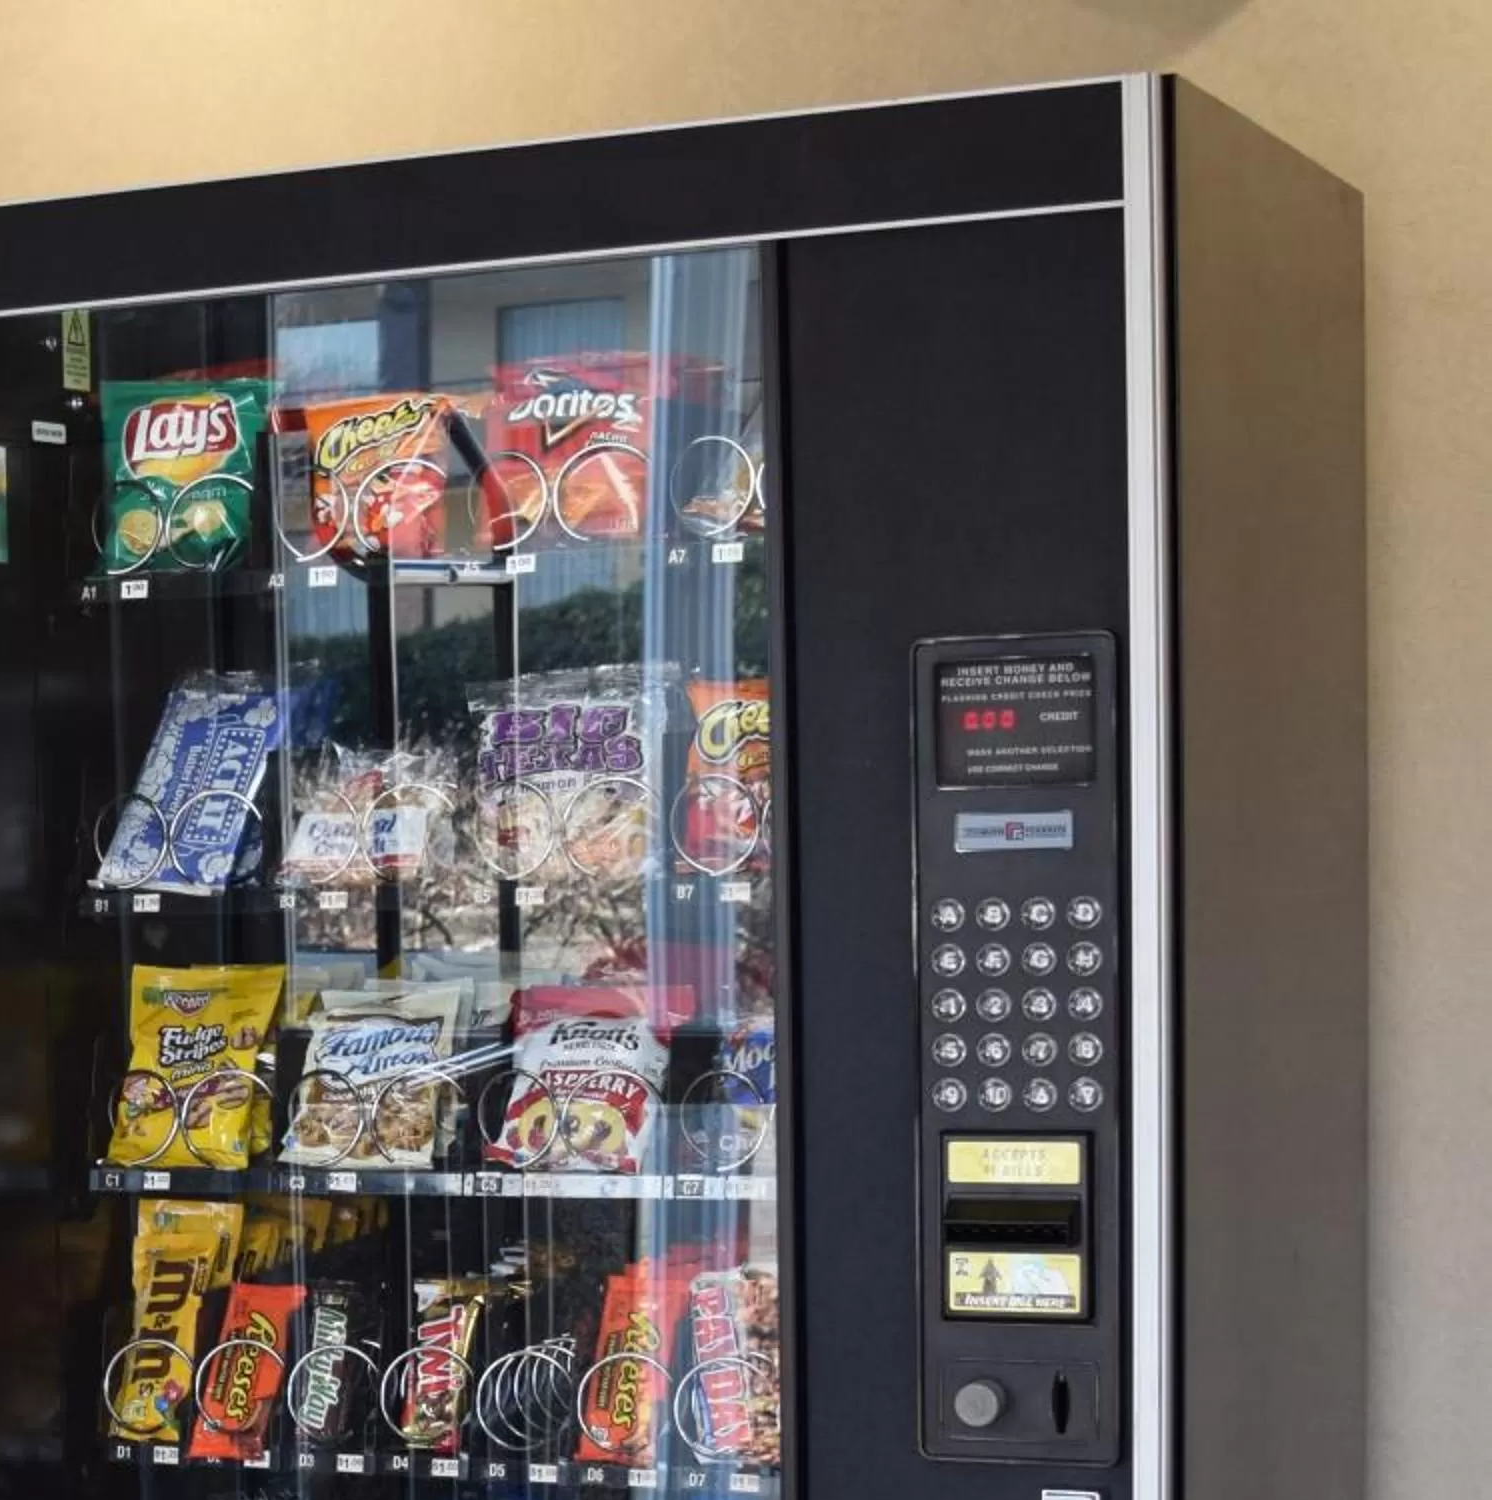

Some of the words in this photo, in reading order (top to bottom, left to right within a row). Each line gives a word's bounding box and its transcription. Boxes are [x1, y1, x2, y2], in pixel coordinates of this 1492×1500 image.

[131, 401, 230, 461] Lay's
[81, 586, 98, 600] A1
[957, 666, 1000, 678] INSERT
[1049, 662, 1074, 673] AND
[995, 674, 1044, 686] CHANGE
[1039, 711, 1080, 723] CREDIT
[116, 1445, 131, 1459] D1
[393, 1456, 408, 1470] D4
[489, 1463, 505, 1478] D5
[587, 1468, 604, 1482] D6
